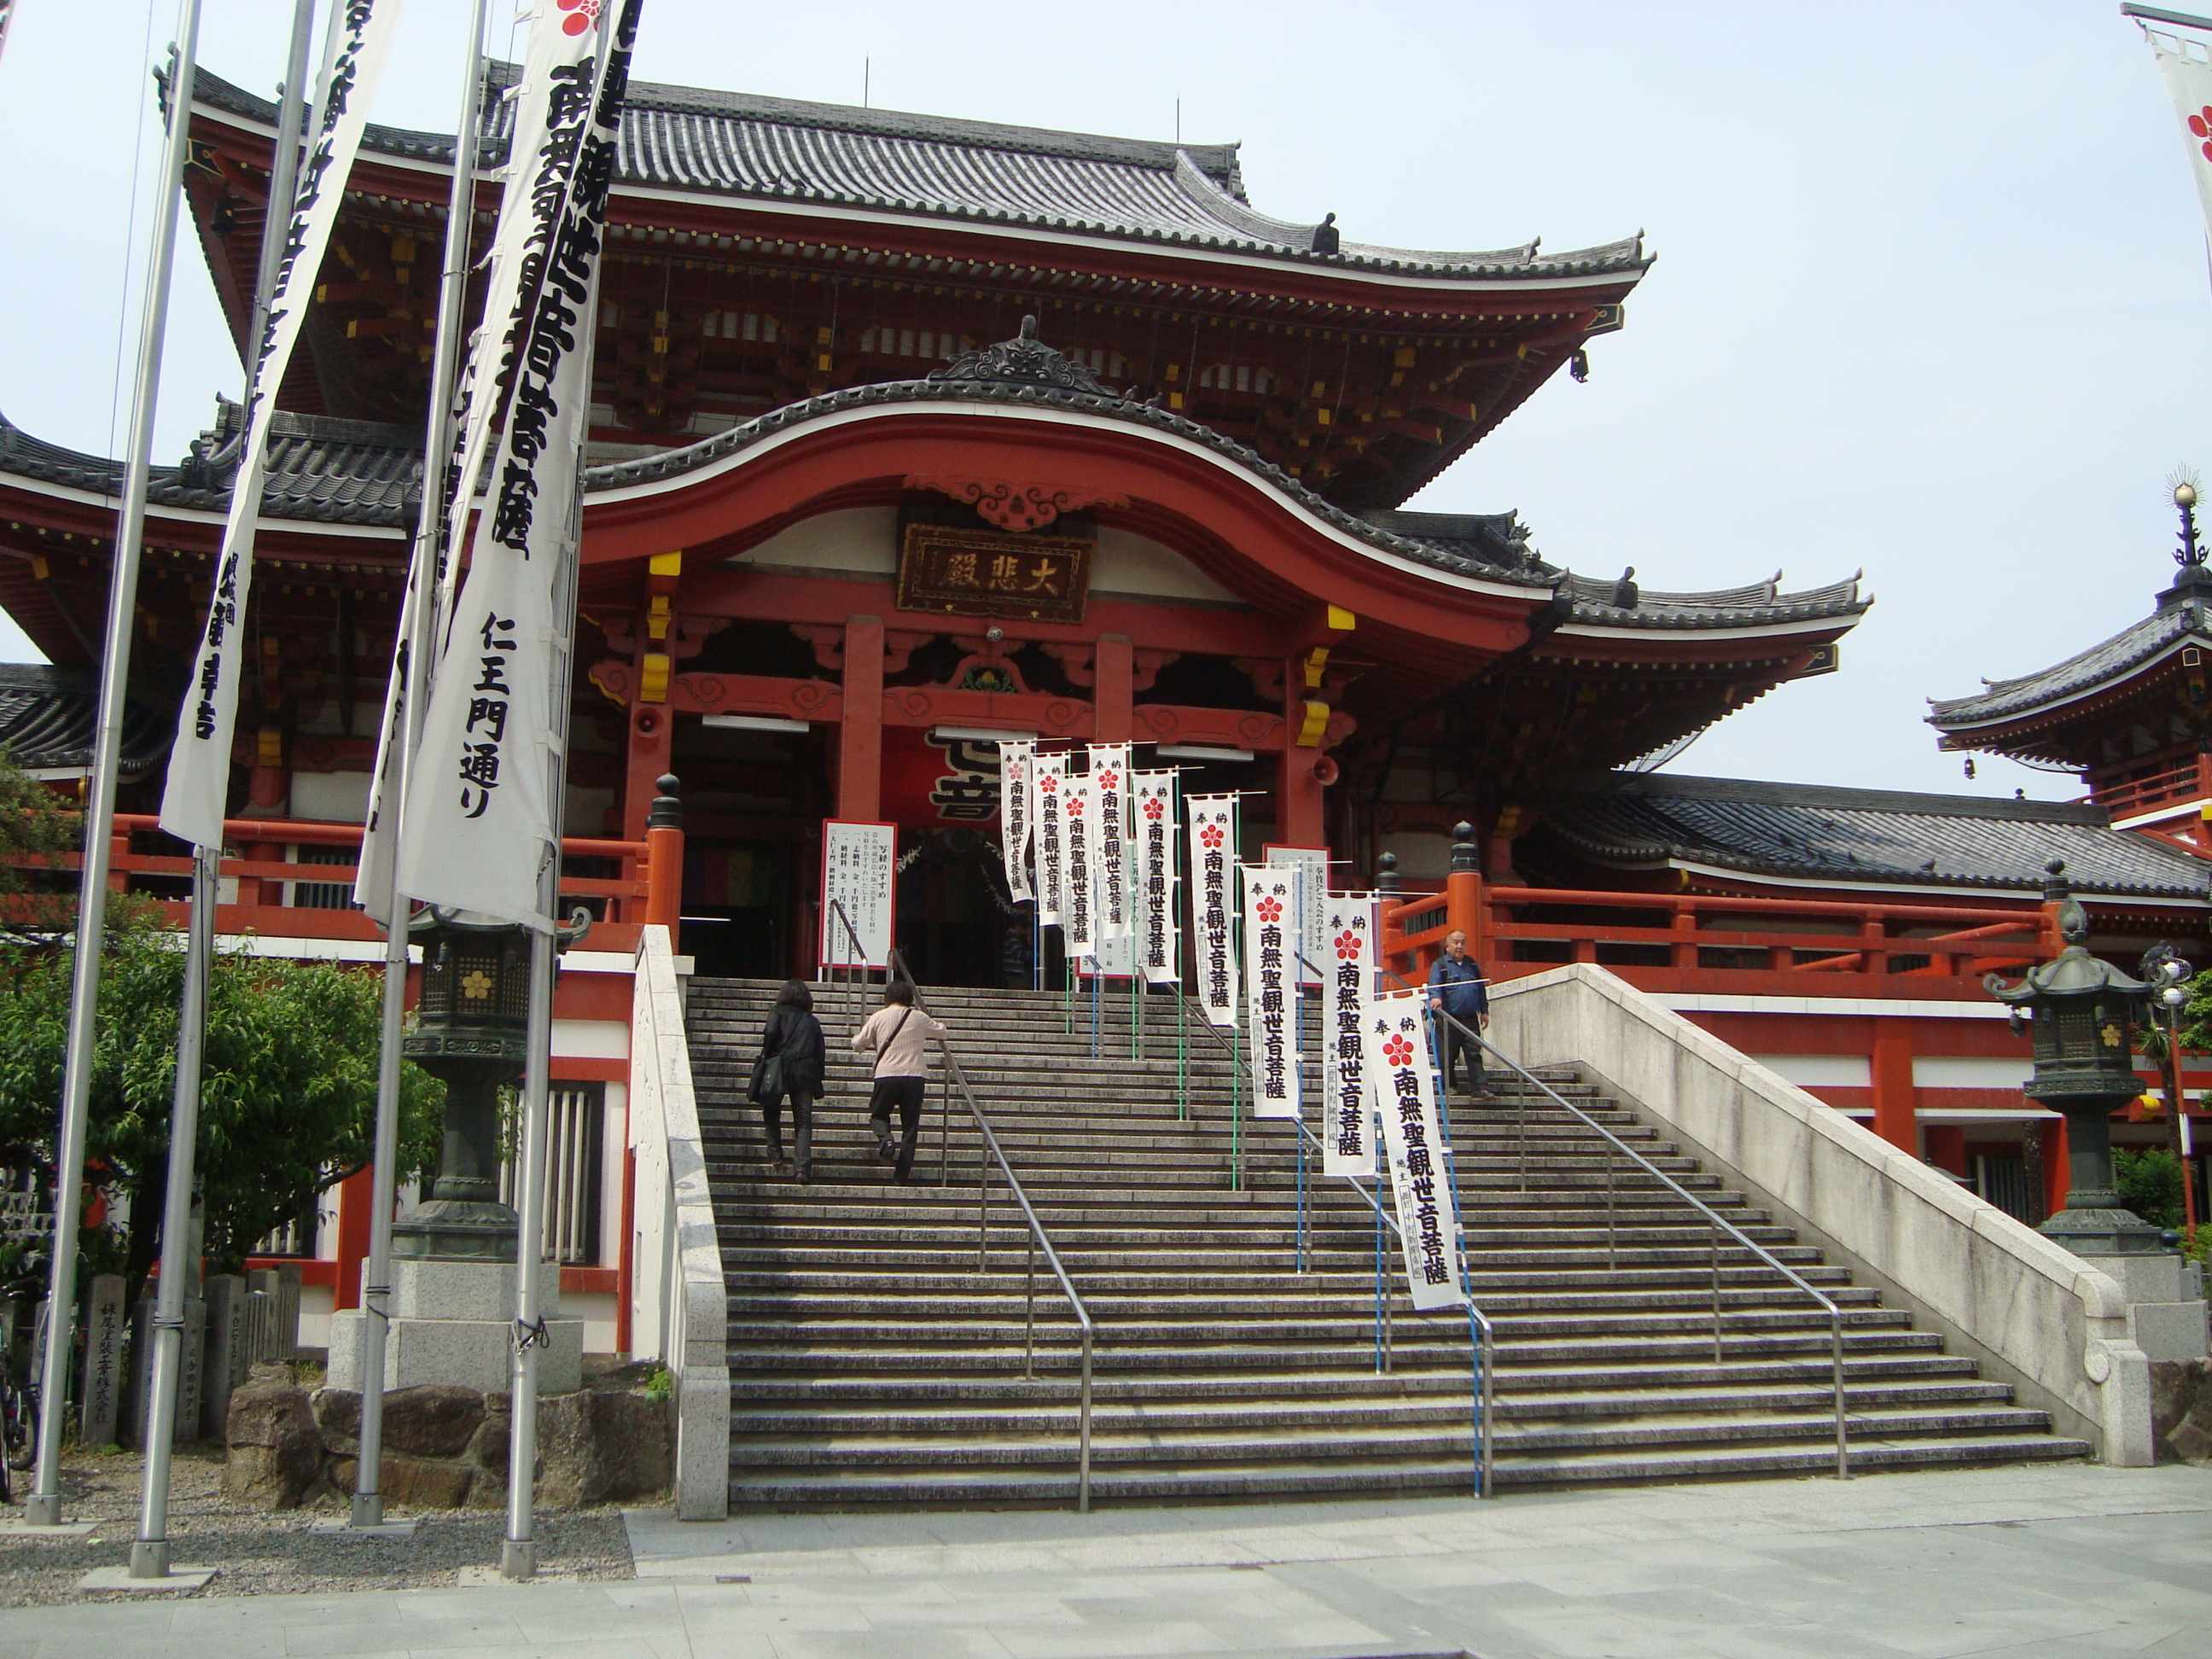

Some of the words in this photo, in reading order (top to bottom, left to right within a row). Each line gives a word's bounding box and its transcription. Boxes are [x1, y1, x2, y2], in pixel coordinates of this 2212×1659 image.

[459, 611, 517, 819] 仁王門通り
[1095, 760, 1121, 770] 奉納
[1010, 781, 1024, 890] 南無聖観世音菩薩
[1139, 787, 1167, 799] 奉納
[1195, 812, 1227, 824] 奉納
[878, 845, 888, 899] 写経のすすめ
[1043, 795, 1060, 912] 南無聖観世音菩薩
[1069, 818, 1089, 943] 南無聖観世音菩薩
[1102, 791, 1121, 923] 南無聖観世音菩薩
[1148, 822, 1166, 967] 南無聖観世音菩薩
[1249, 882, 1286, 896] 奉納
[1203, 849, 1230, 1008] 南無聖観世音菩薩
[1330, 915, 1365, 931] 奉納
[1260, 924, 1287, 1099] 南無聖観世音菩薩
[1336, 961, 1364, 1156] 南無聖観世音菩薩
[1374, 1017, 1416, 1036] 奉納
[1394, 1068, 1450, 1285] 南無聖観世音菩薩
